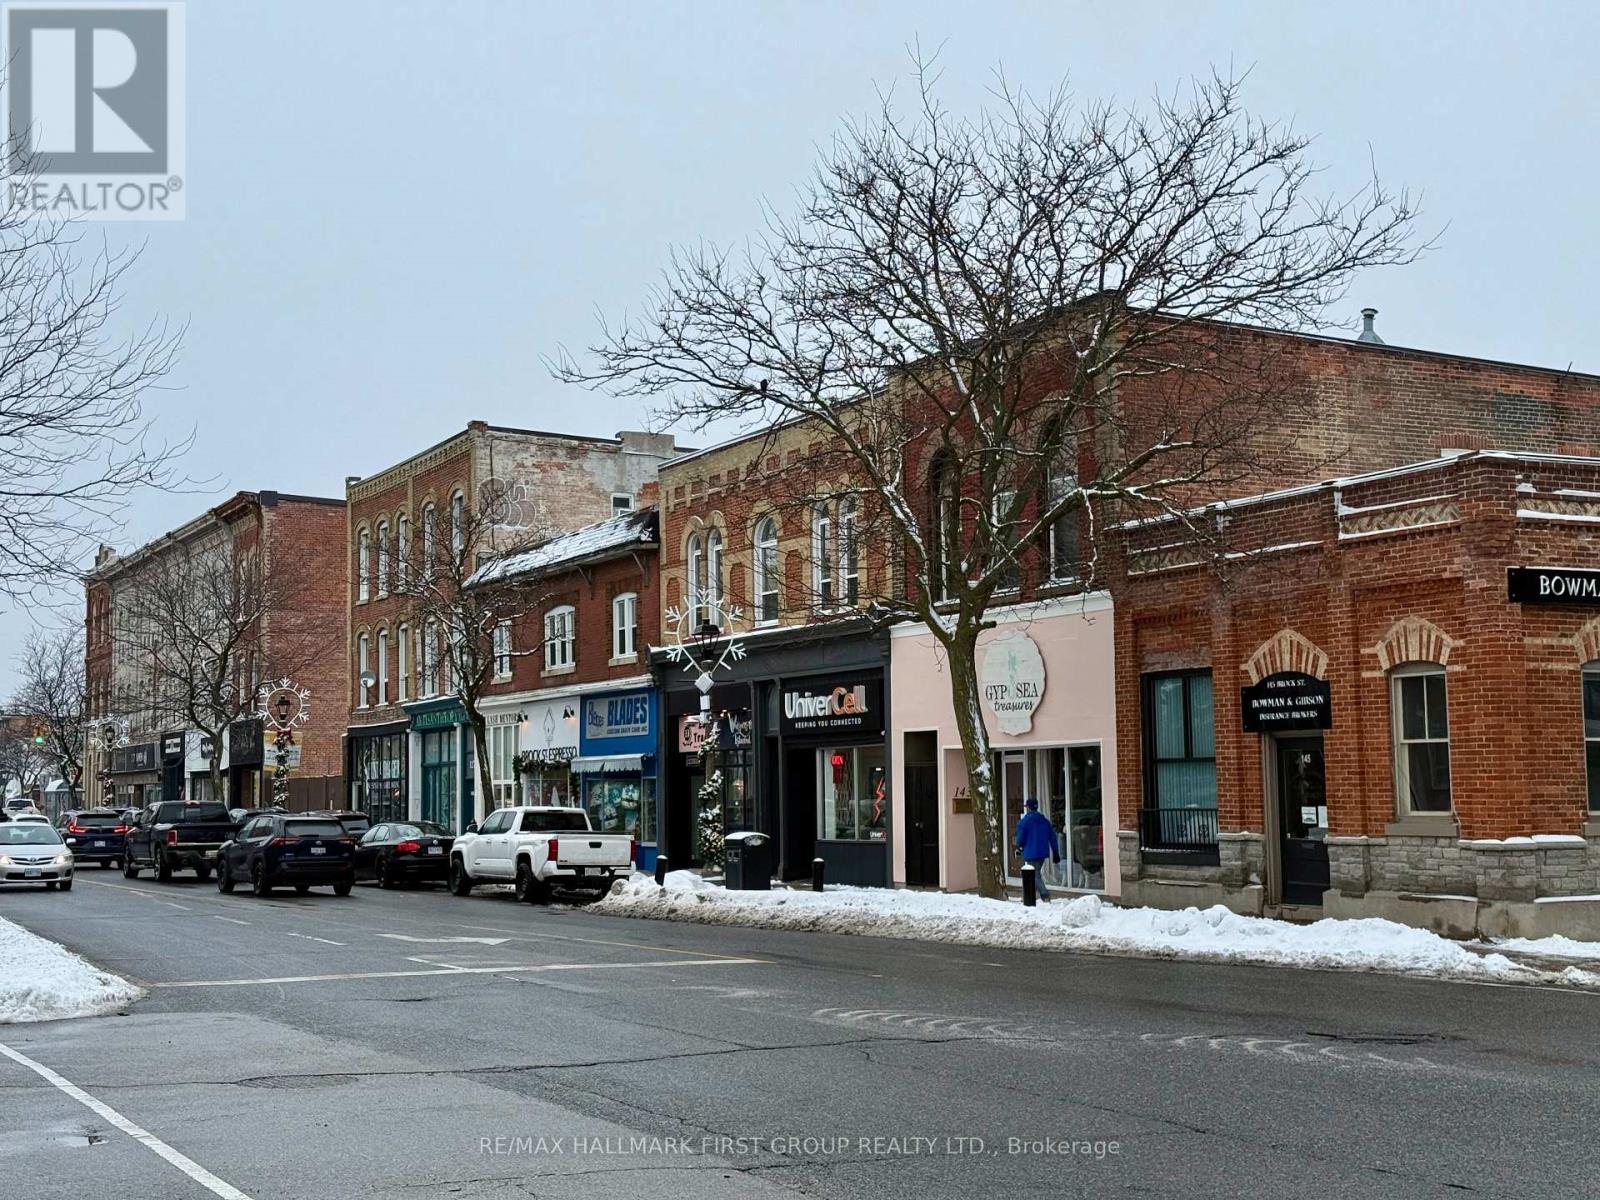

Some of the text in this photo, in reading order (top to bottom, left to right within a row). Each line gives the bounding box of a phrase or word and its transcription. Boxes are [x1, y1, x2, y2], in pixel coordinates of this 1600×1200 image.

[1539, 575, 1600, 597] BOWM
[1016, 681, 1039, 698] SEA
[784, 685, 868, 719] UniverCell
[994, 700, 1034, 711] treasures
[1252, 695, 1324, 708] BOWMAN & GIBSON
[607, 696, 647, 727] BLADES
[1259, 712, 1290, 720] INSURANCE
[830, 718, 862, 726] CONNECTED
[548, 746, 577, 761] ESPRESSO
